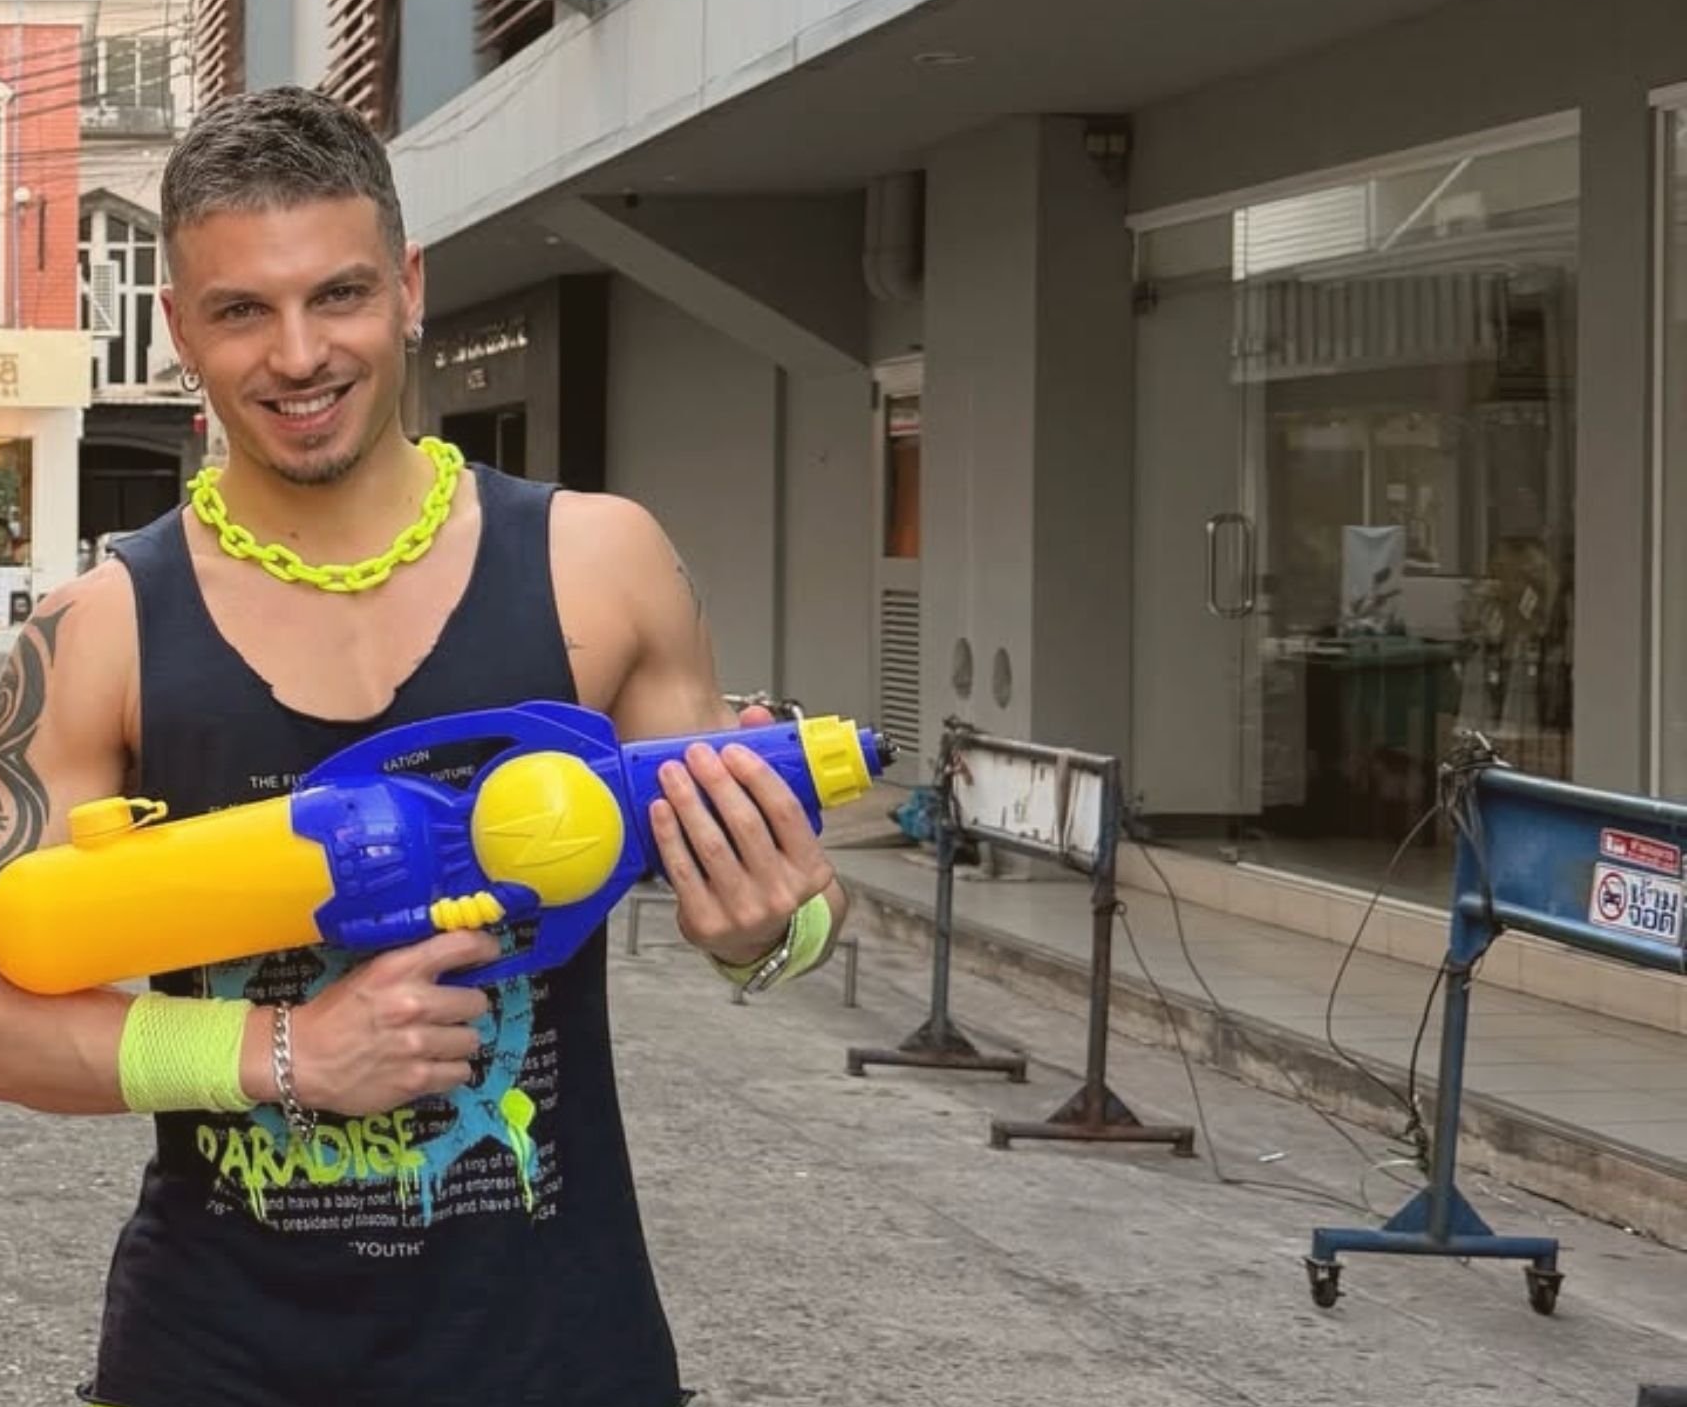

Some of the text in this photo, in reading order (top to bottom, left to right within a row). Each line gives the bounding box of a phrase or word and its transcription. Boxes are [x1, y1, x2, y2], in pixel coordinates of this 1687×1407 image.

[249, 774, 280, 790] THE
[1631, 878, 1678, 913] ห้าม
[1629, 905, 1676, 935] จอด
[197, 1110, 425, 1188] PARADISE
